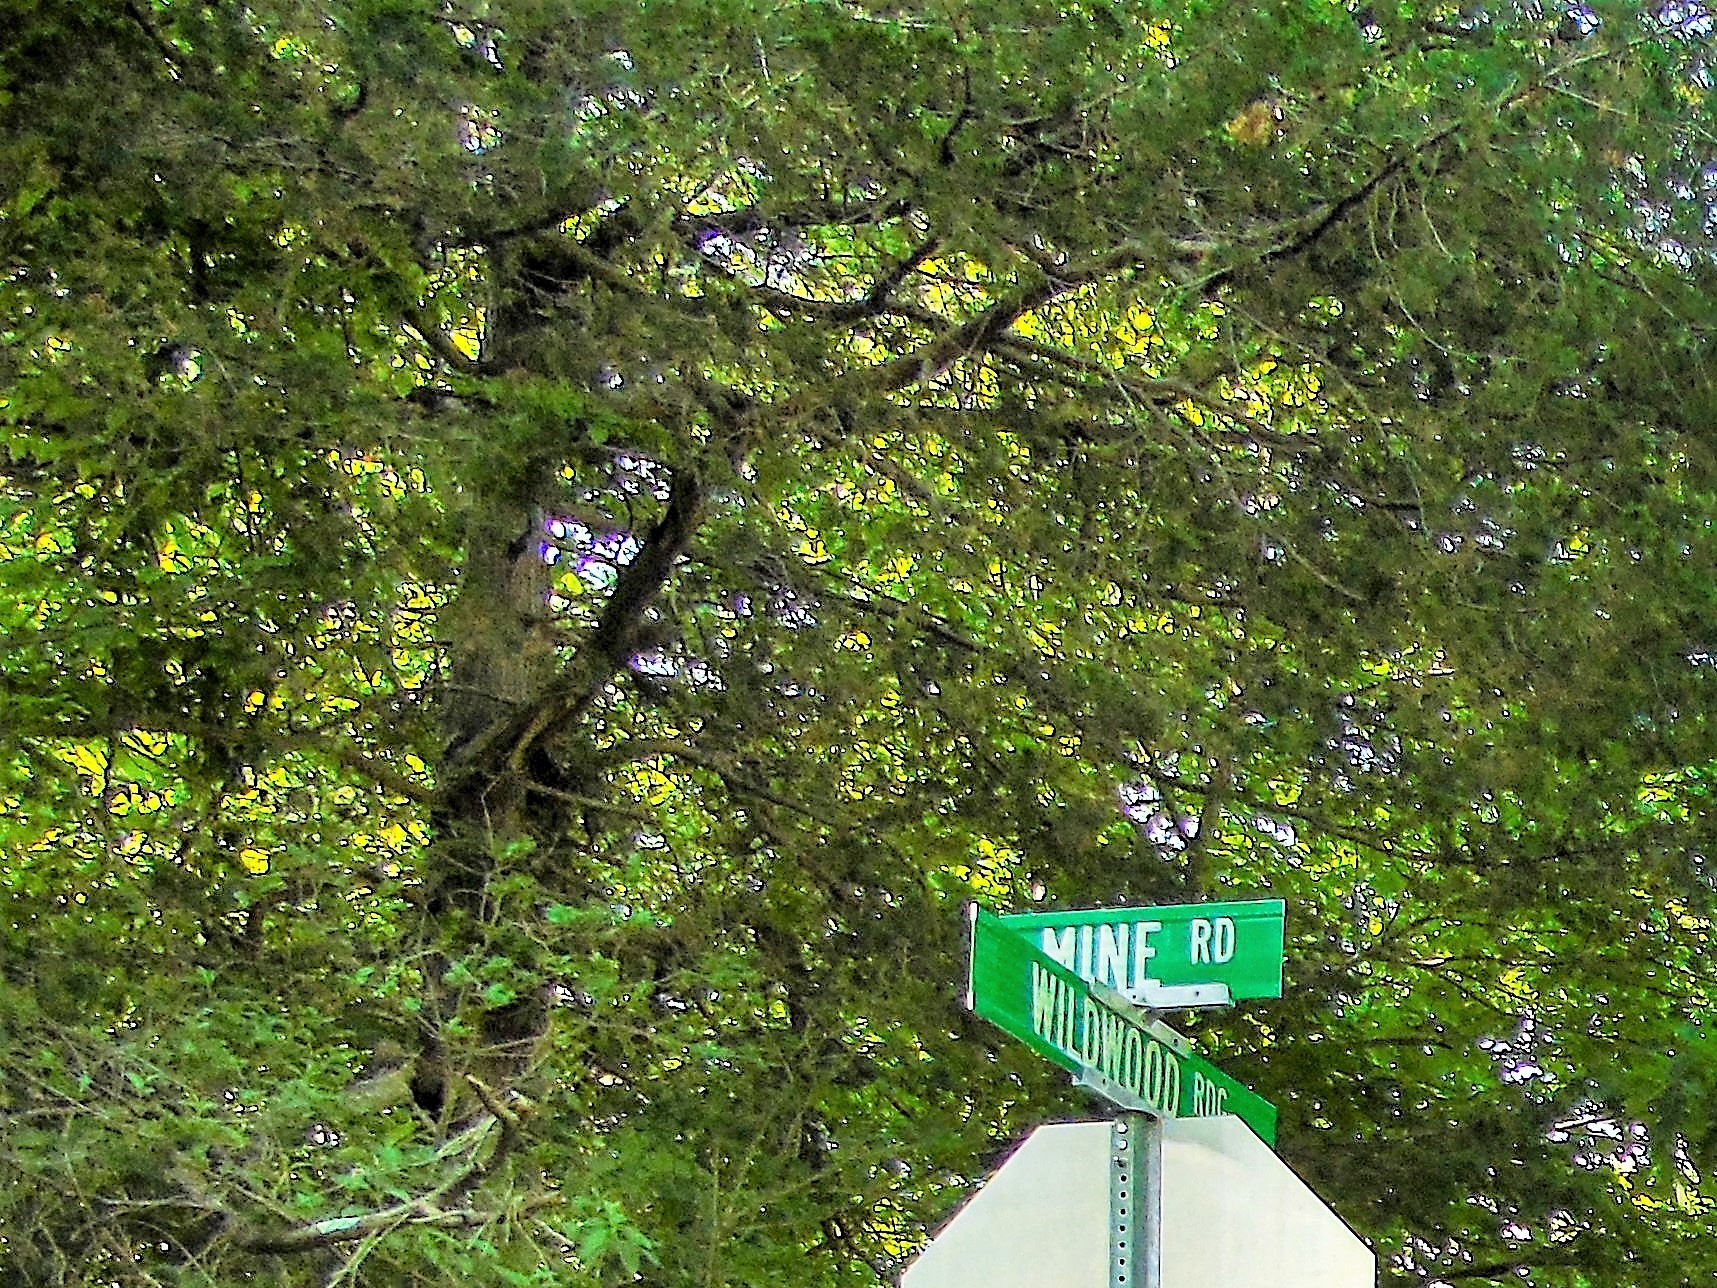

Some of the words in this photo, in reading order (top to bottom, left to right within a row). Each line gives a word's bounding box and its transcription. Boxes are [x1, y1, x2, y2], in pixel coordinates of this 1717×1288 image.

[1043, 921, 1162, 990] MINE
[1190, 917, 1237, 965] RD
[1031, 961, 1180, 1119] WILDWOOD
